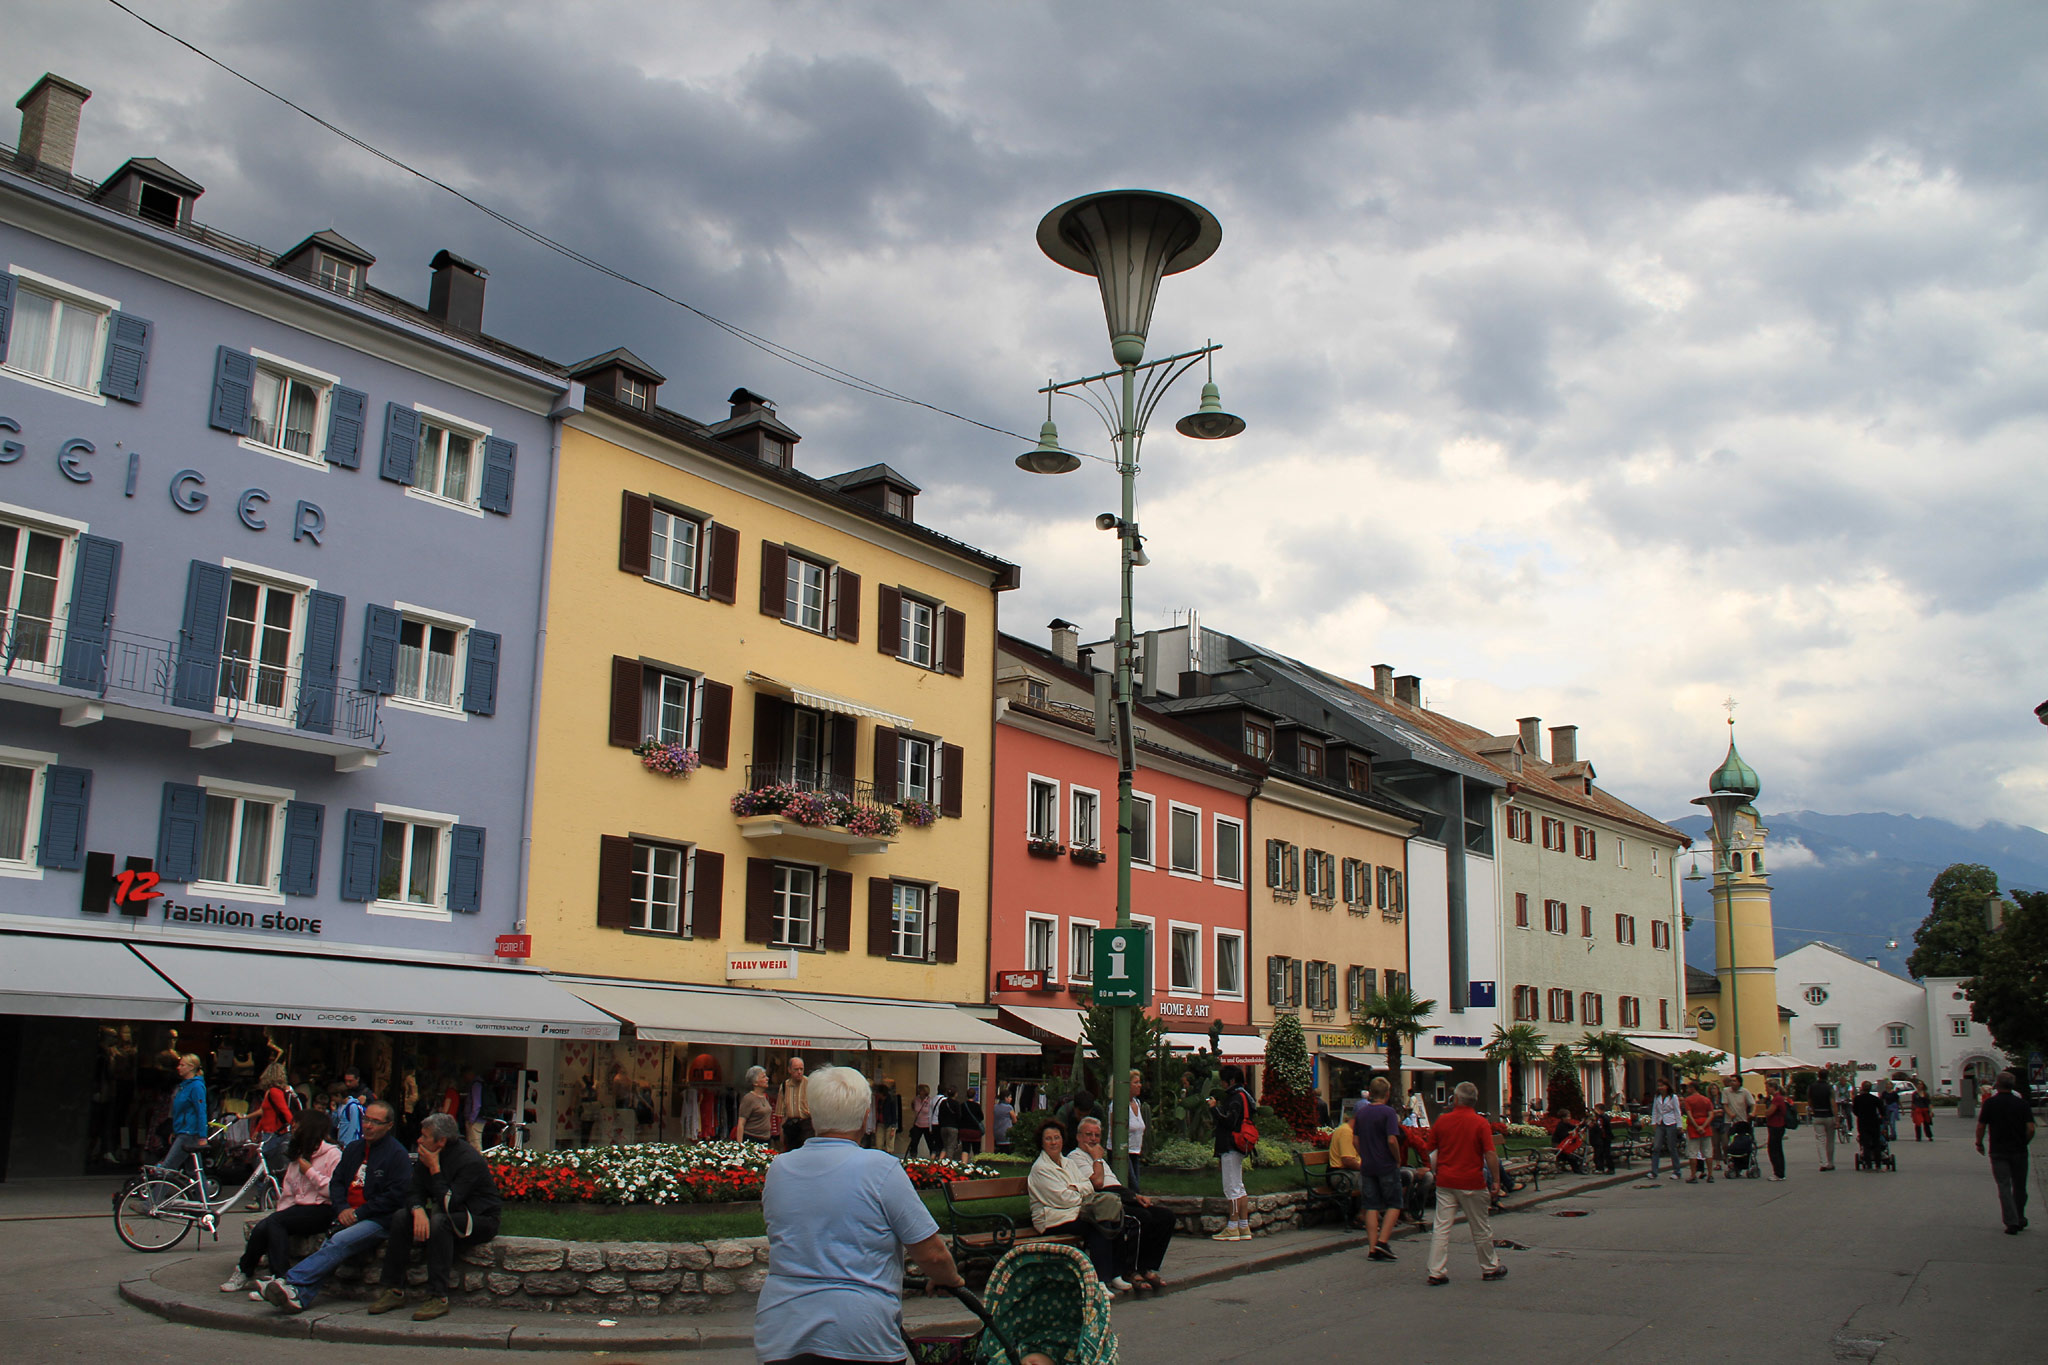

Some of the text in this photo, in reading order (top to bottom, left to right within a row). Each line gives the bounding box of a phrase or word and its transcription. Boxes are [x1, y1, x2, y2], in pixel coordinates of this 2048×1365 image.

[163, 900, 322, 934] fashion store
[500, 942, 518, 952] name
[731, 961, 757, 969] TALLY
[1005, 974, 1039, 988] Tirol
[1160, 1002, 1209, 1017] HOME & ART
[275, 1012, 302, 1021] ONLY
[427, 1018, 464, 1027] SELECTED
[769, 1038, 790, 1046] TALLY
